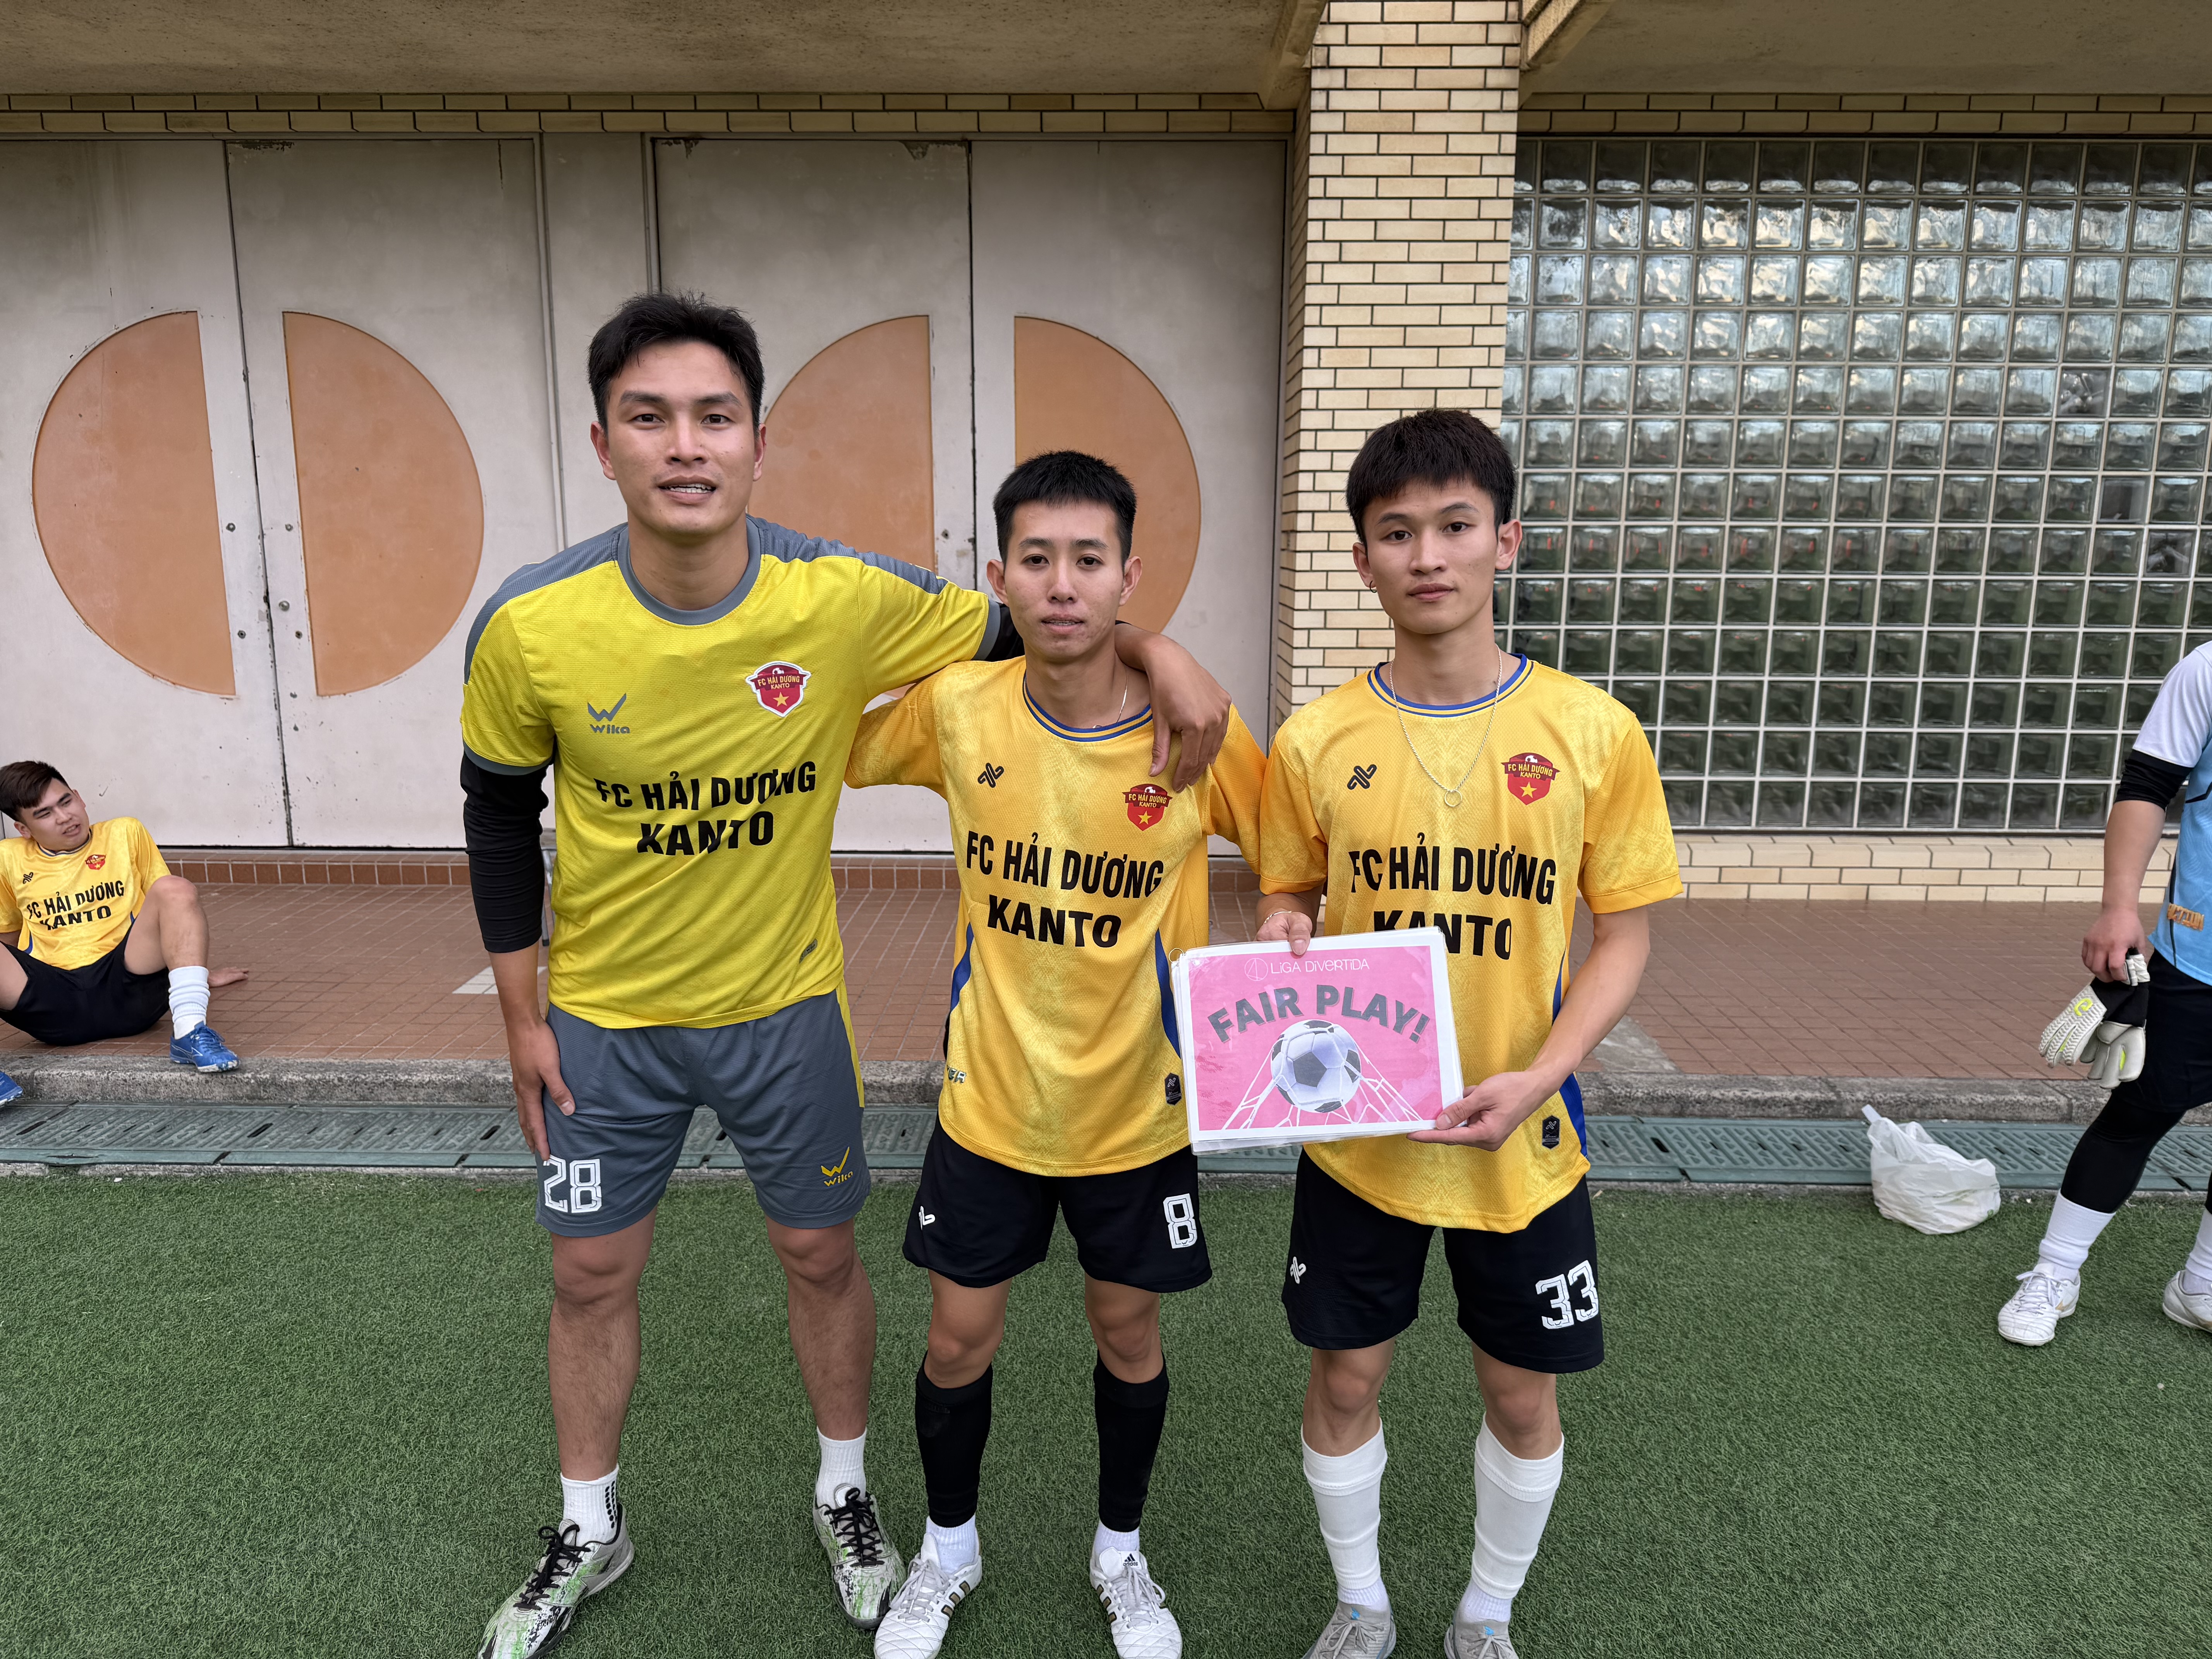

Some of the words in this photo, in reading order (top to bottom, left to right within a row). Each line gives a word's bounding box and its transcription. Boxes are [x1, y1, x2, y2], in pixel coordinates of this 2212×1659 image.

[757, 678, 766, 686] FC
[780, 675, 800, 683] DƯƠNG
[593, 778, 633, 807] FC
[641, 771, 699, 811] HẢI
[711, 761, 816, 807] DƯƠNG
[1531, 765, 1553, 776] DƯƠNG
[636, 811, 774, 855] KANTO
[966, 831, 994, 875] FC
[1003, 832, 1052, 888] HẢI
[1060, 849, 1164, 898] DƯƠNG
[1348, 849, 1382, 893] FC
[1389, 832, 1440, 891] HẢI
[1452, 843, 1556, 905] DƯƠNG
[27, 902, 41, 919] FC
[43, 891, 72, 915] HẢI
[75, 880, 124, 906] DƯƠNG
[39, 905, 111, 930] KANTO
[987, 894, 1121, 948] KANTO
[1207, 986, 1304, 1044] FAIR
[1317, 984, 1430, 1044] PLAY!
[543, 1154, 602, 1213] 28
[1163, 1193, 1197, 1249] 8
[1535, 1260, 1599, 1329] 33
